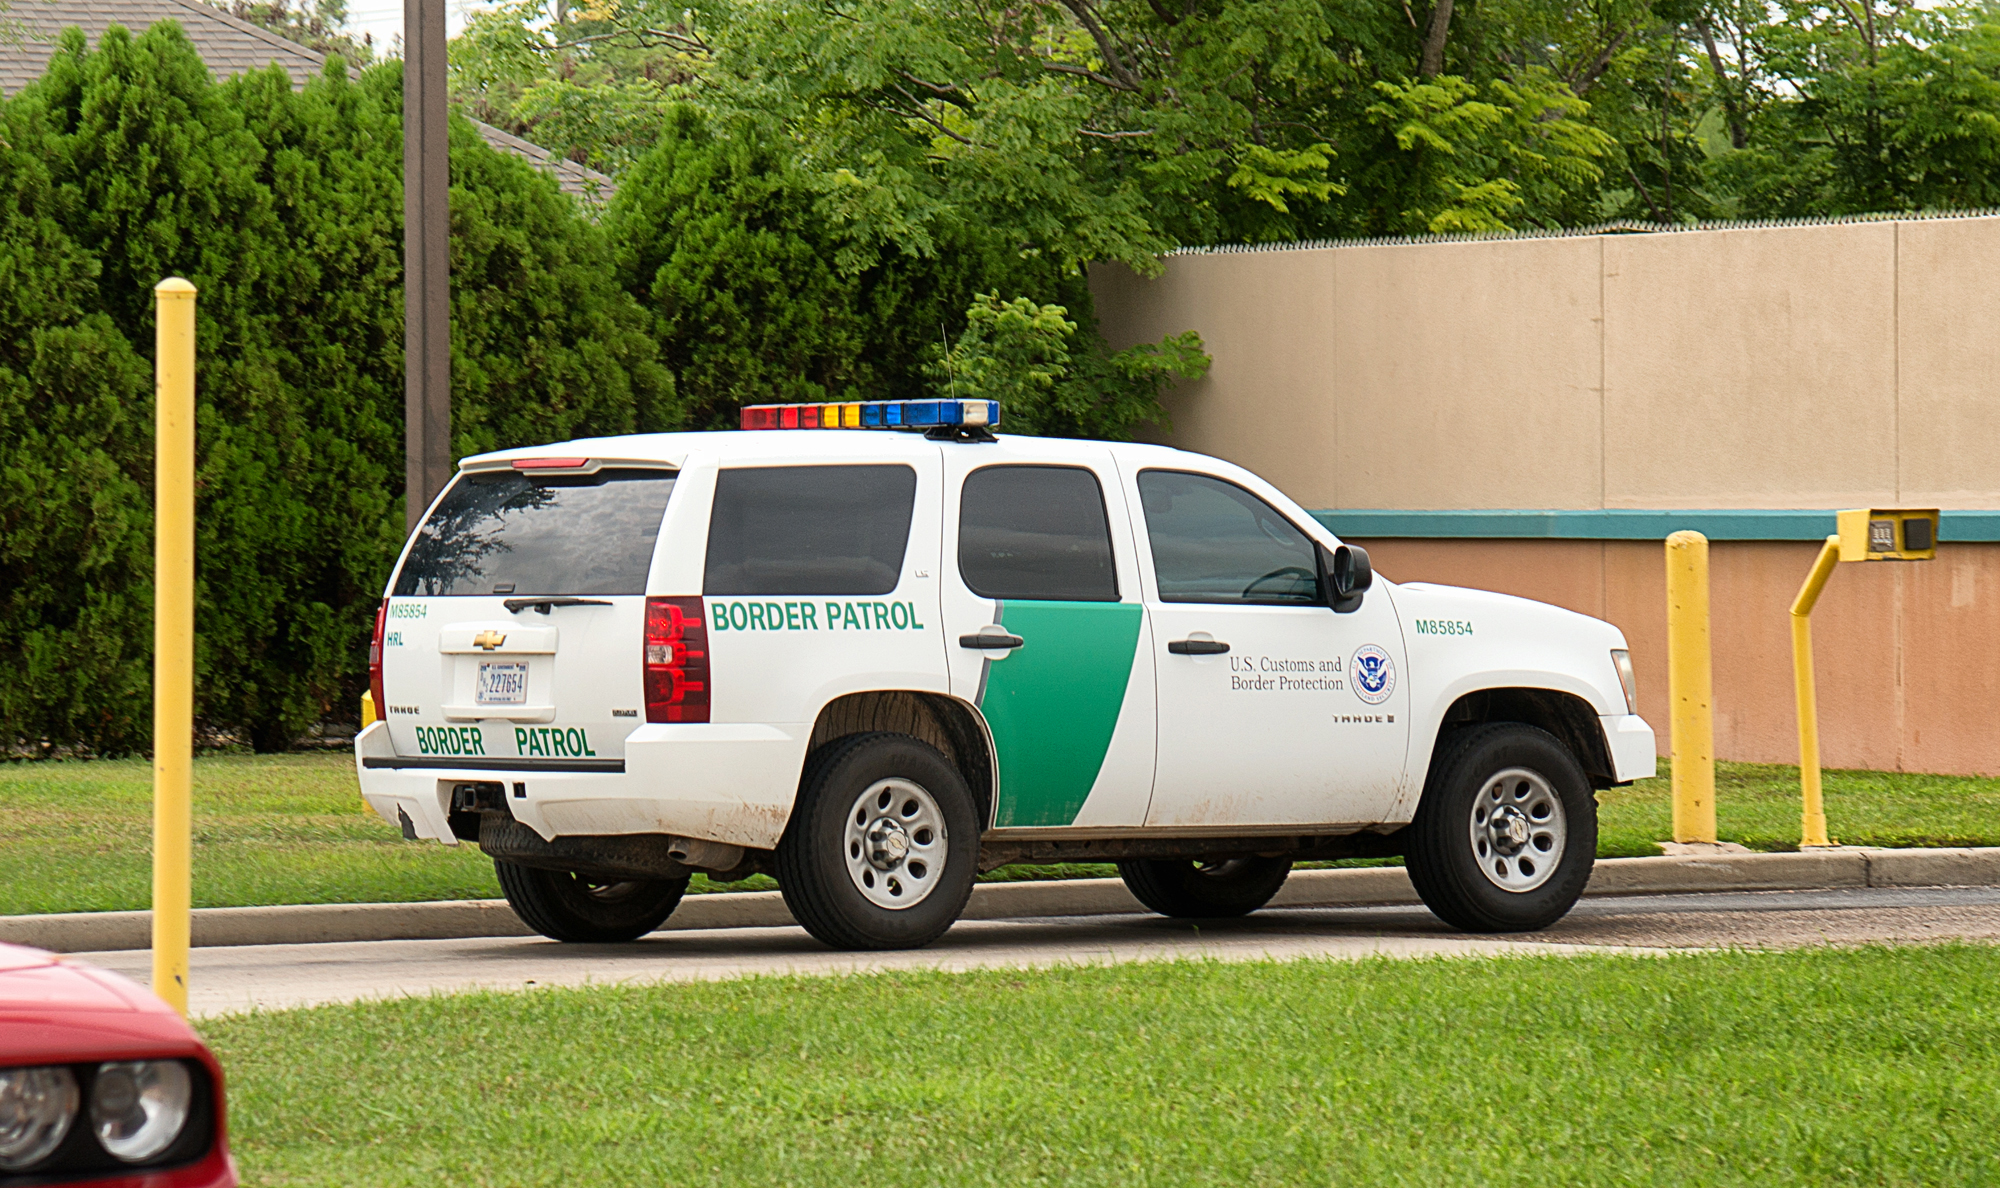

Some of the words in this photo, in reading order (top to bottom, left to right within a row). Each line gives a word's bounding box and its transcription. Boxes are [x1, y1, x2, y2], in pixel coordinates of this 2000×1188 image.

[390, 603, 427, 619] M85854
[711, 601, 819, 631] BORDER
[825, 601, 924, 630] PATROL
[1415, 619, 1473, 636] M85854
[387, 631, 403, 647] HRL
[1230, 656, 1257, 672] U.S.
[1260, 656, 1315, 672] Customs
[1319, 656, 1343, 672] and
[489, 673, 523, 693] 227654
[1231, 674, 1275, 691] Border
[1279, 675, 1344, 691] Protection
[389, 705, 420, 715] TAHOE
[415, 726, 485, 756] BORDER
[515, 727, 596, 757] PATROL
